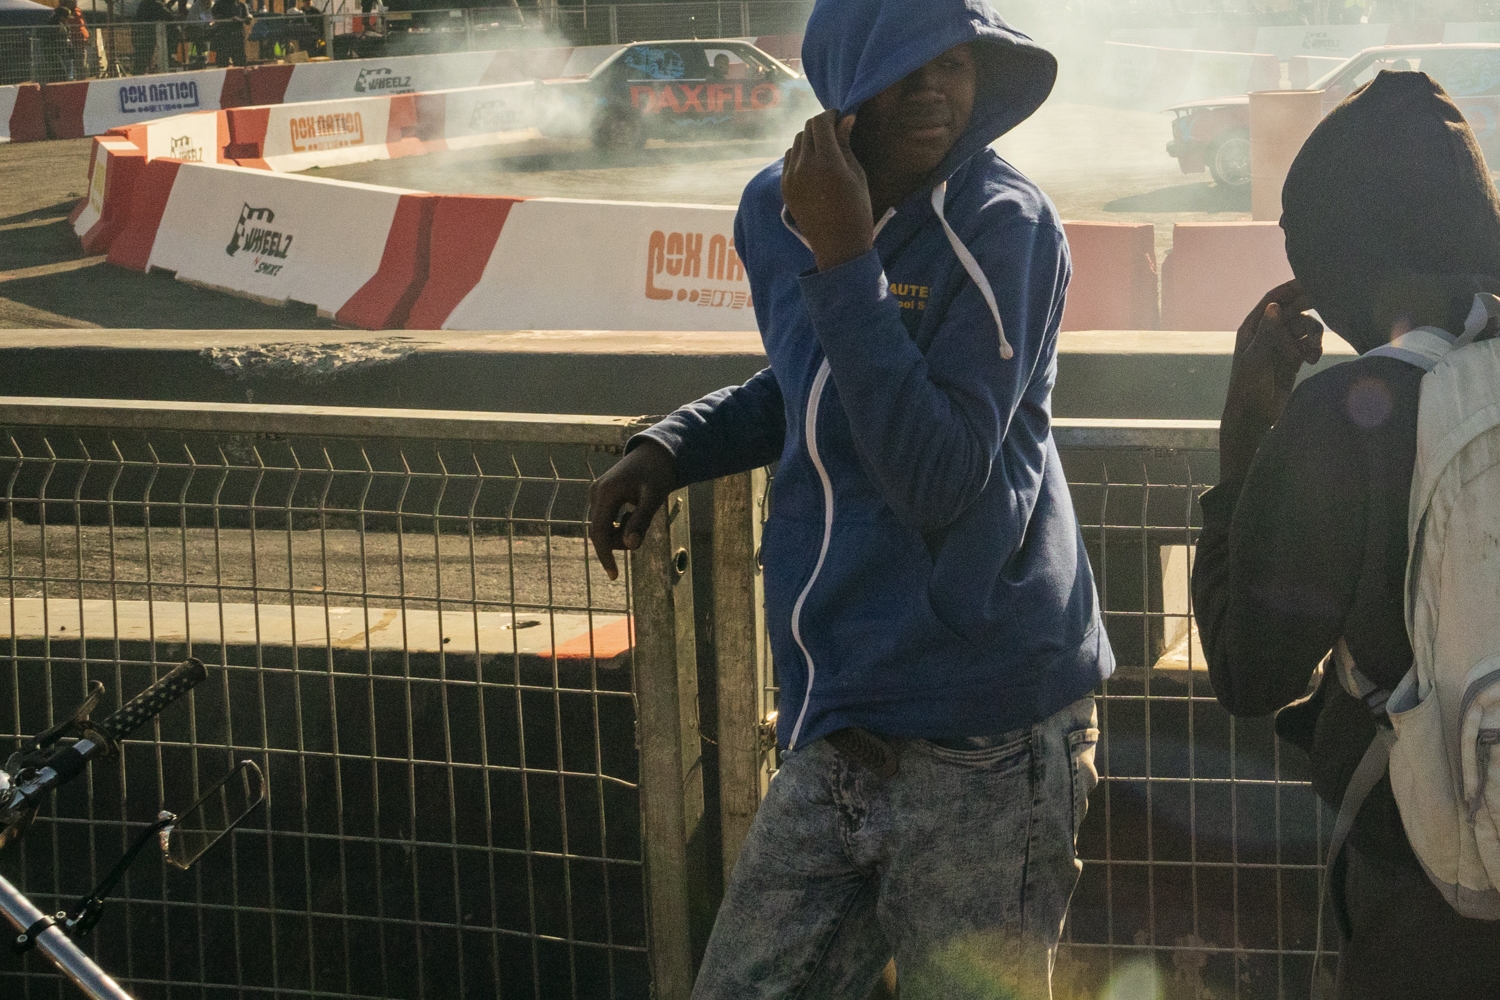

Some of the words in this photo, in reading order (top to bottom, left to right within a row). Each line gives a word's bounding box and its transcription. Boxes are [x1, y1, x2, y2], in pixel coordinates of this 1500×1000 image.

[149, 81, 199, 104] NATION
[368, 76, 411, 90] WHEELZ
[242, 227, 293, 259] WHEELZ
[645, 230, 703, 286] BOX
